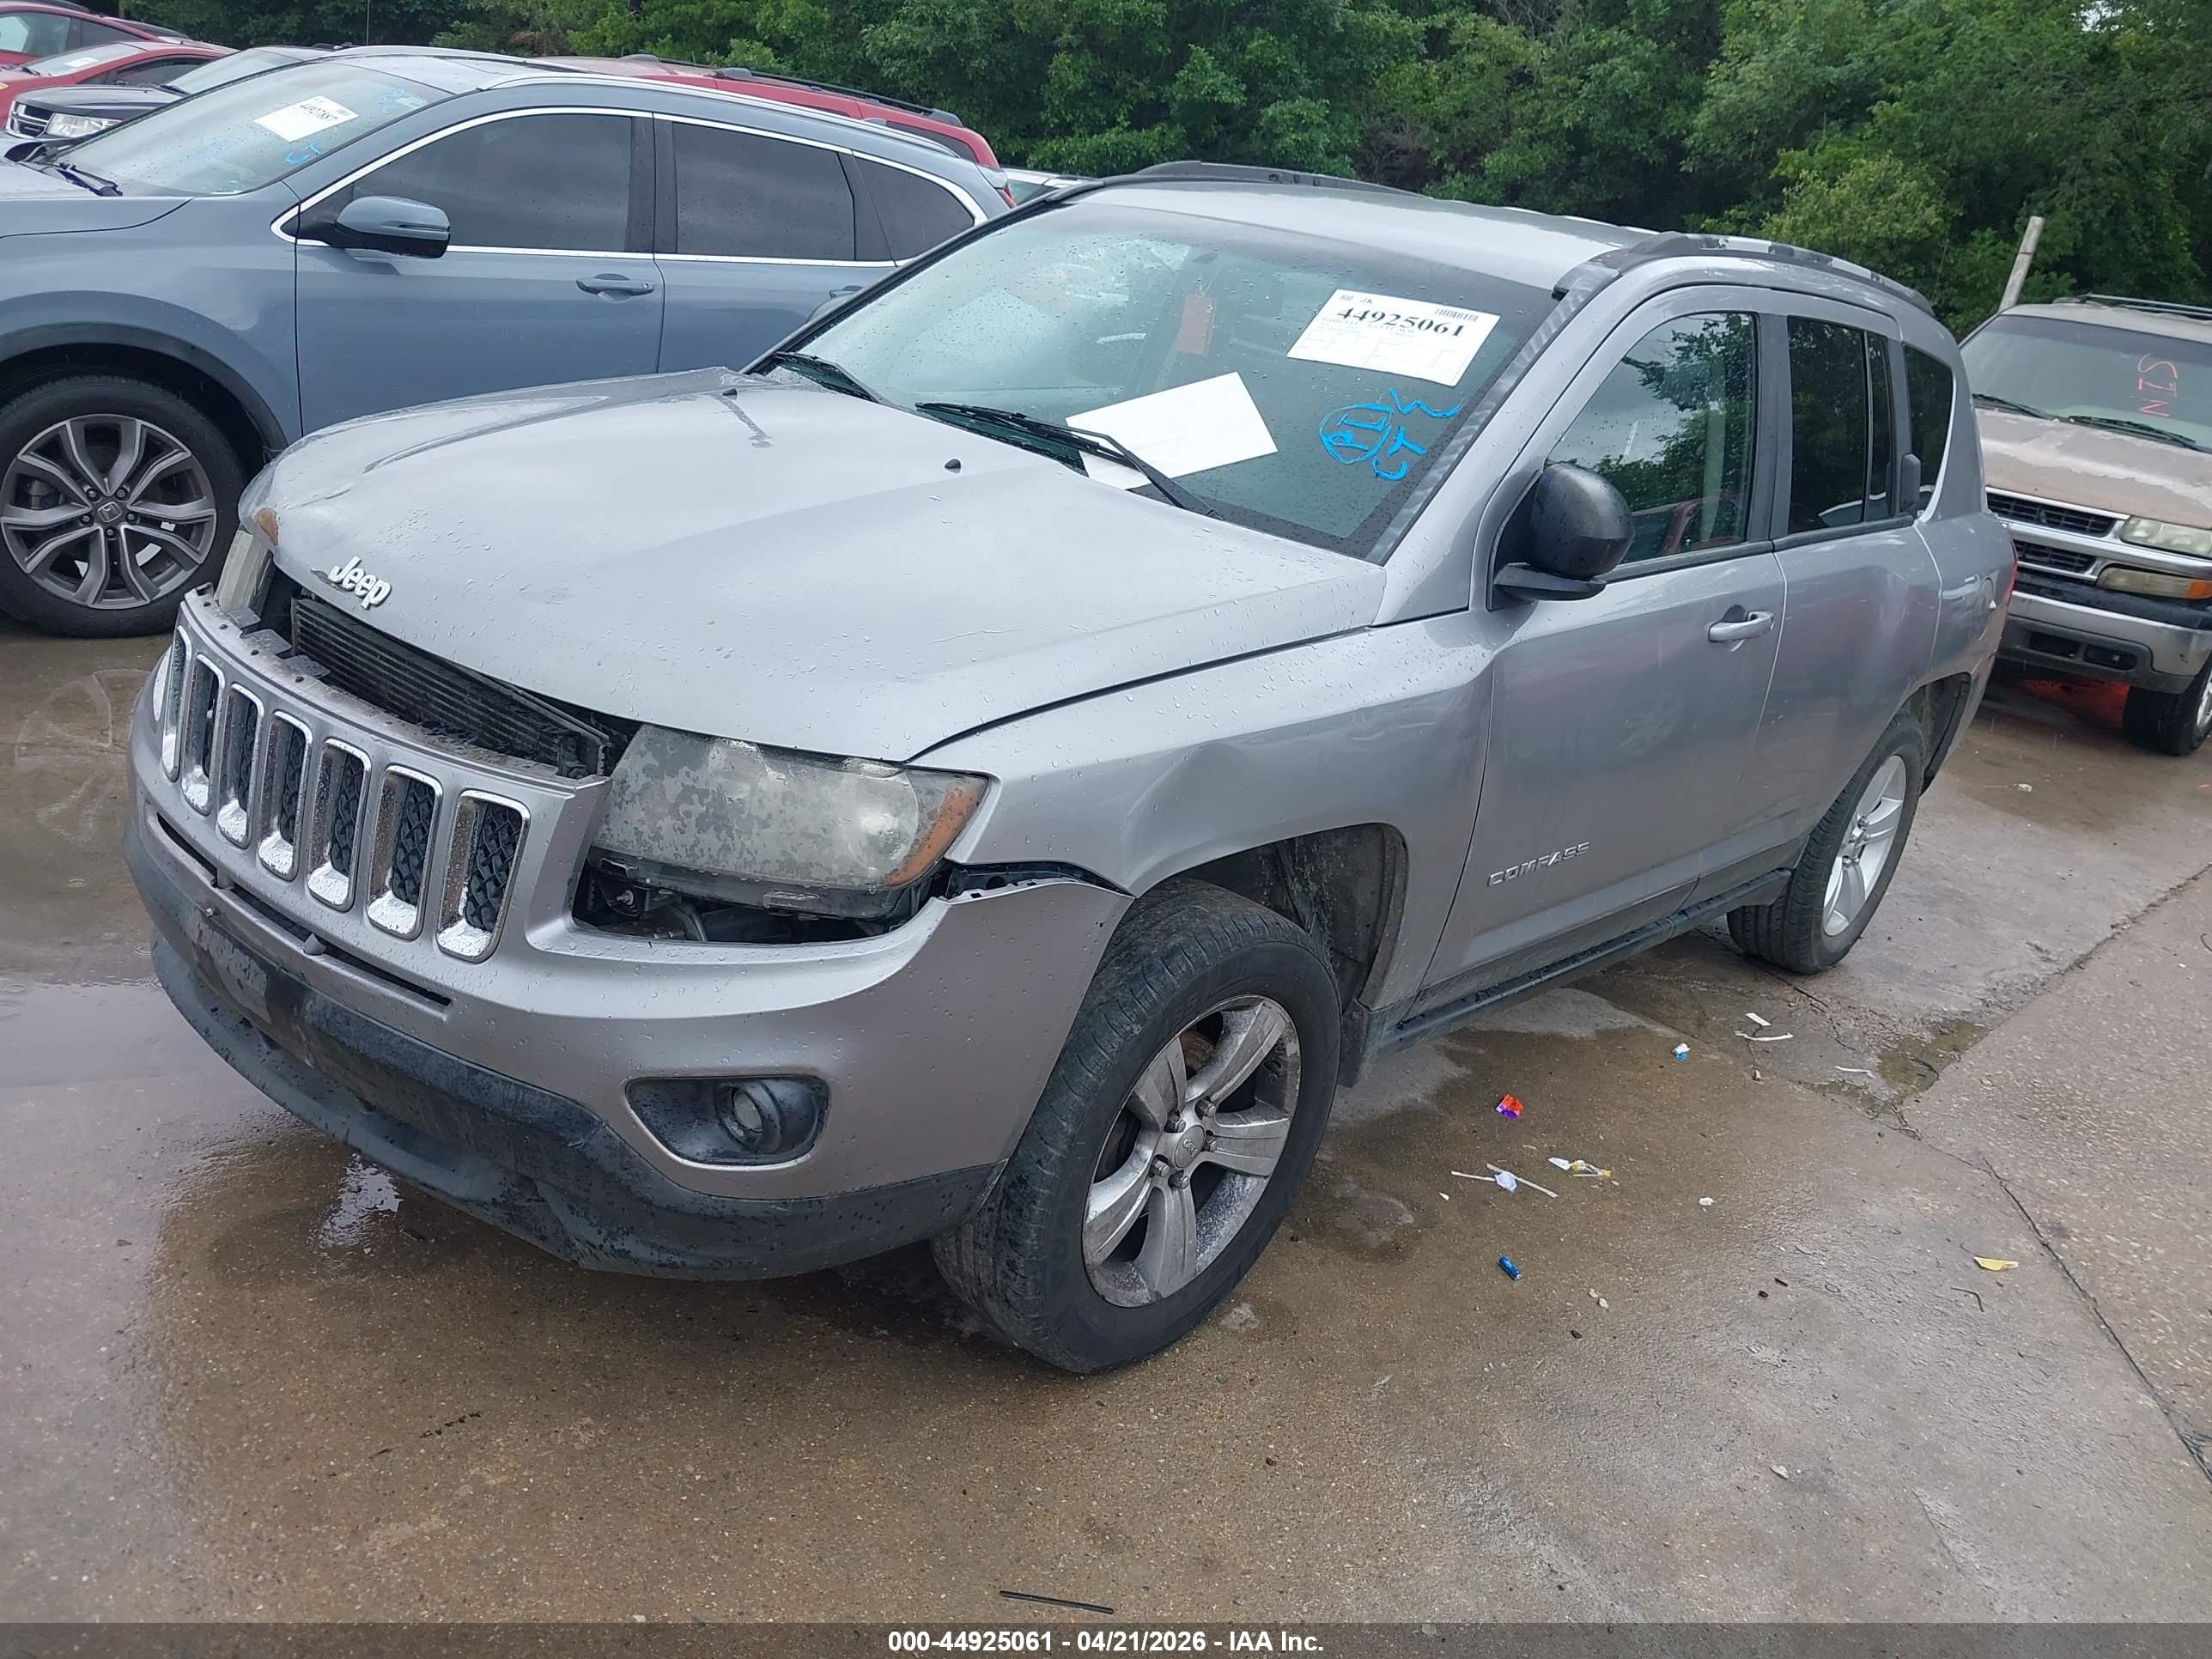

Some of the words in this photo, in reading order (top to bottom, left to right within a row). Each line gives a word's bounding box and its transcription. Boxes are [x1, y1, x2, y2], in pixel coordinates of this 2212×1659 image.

[1336, 307, 1466, 337] 44925061
[329, 556, 392, 611] Jeep
[1486, 842, 1589, 886] COMPASS
